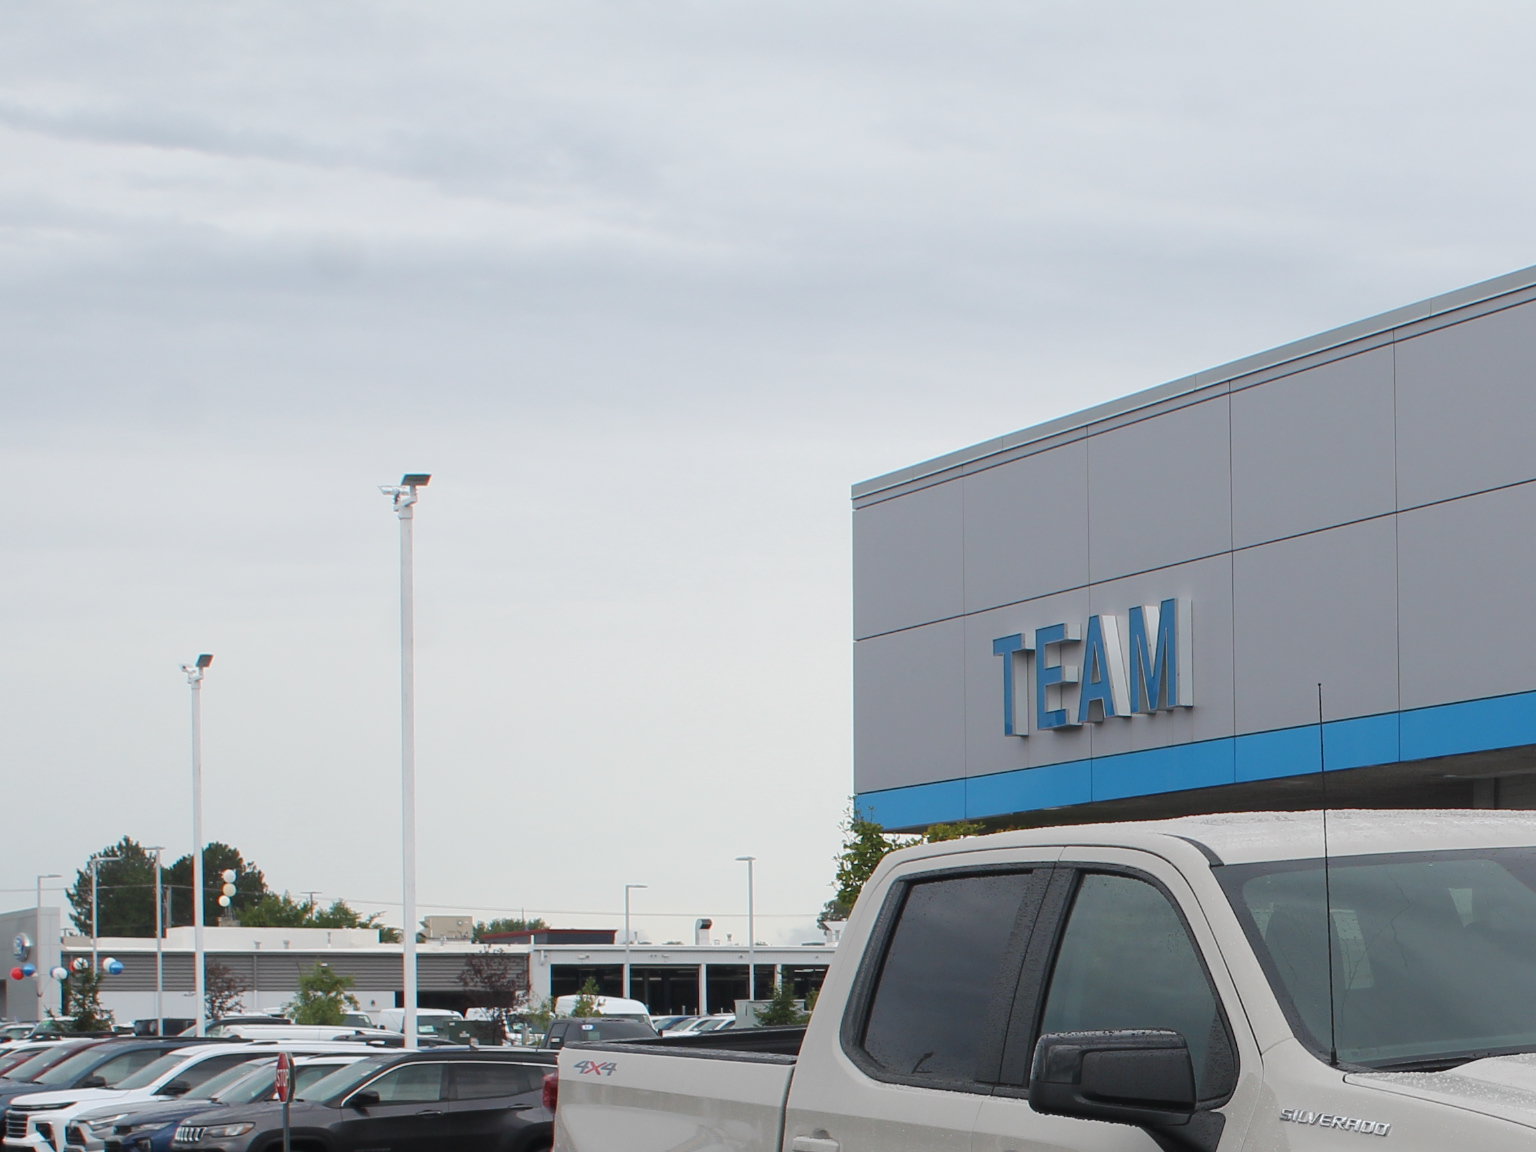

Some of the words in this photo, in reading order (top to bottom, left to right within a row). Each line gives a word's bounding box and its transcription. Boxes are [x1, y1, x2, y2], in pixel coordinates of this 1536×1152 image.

[993, 598, 1193, 737] TEAM
[276, 1068, 290, 1087] STOP
[1280, 1108, 1392, 1137] SILVERADO
